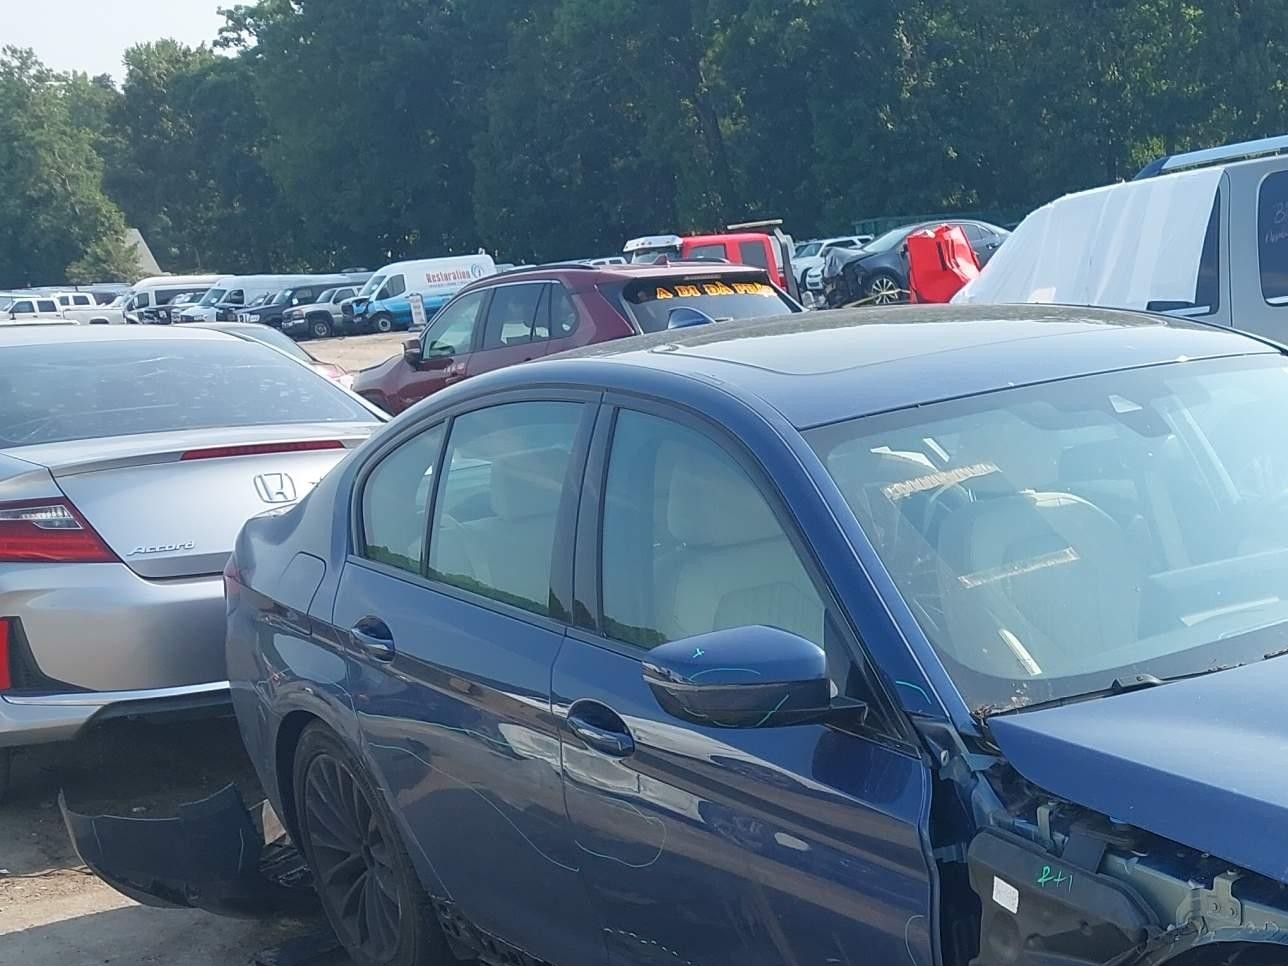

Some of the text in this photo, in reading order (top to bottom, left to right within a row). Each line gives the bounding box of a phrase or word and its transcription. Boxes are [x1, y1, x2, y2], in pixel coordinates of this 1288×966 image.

[426, 270, 471, 283] Restoration
[656, 287, 673, 299] A
[126, 541, 195, 557] Accord
